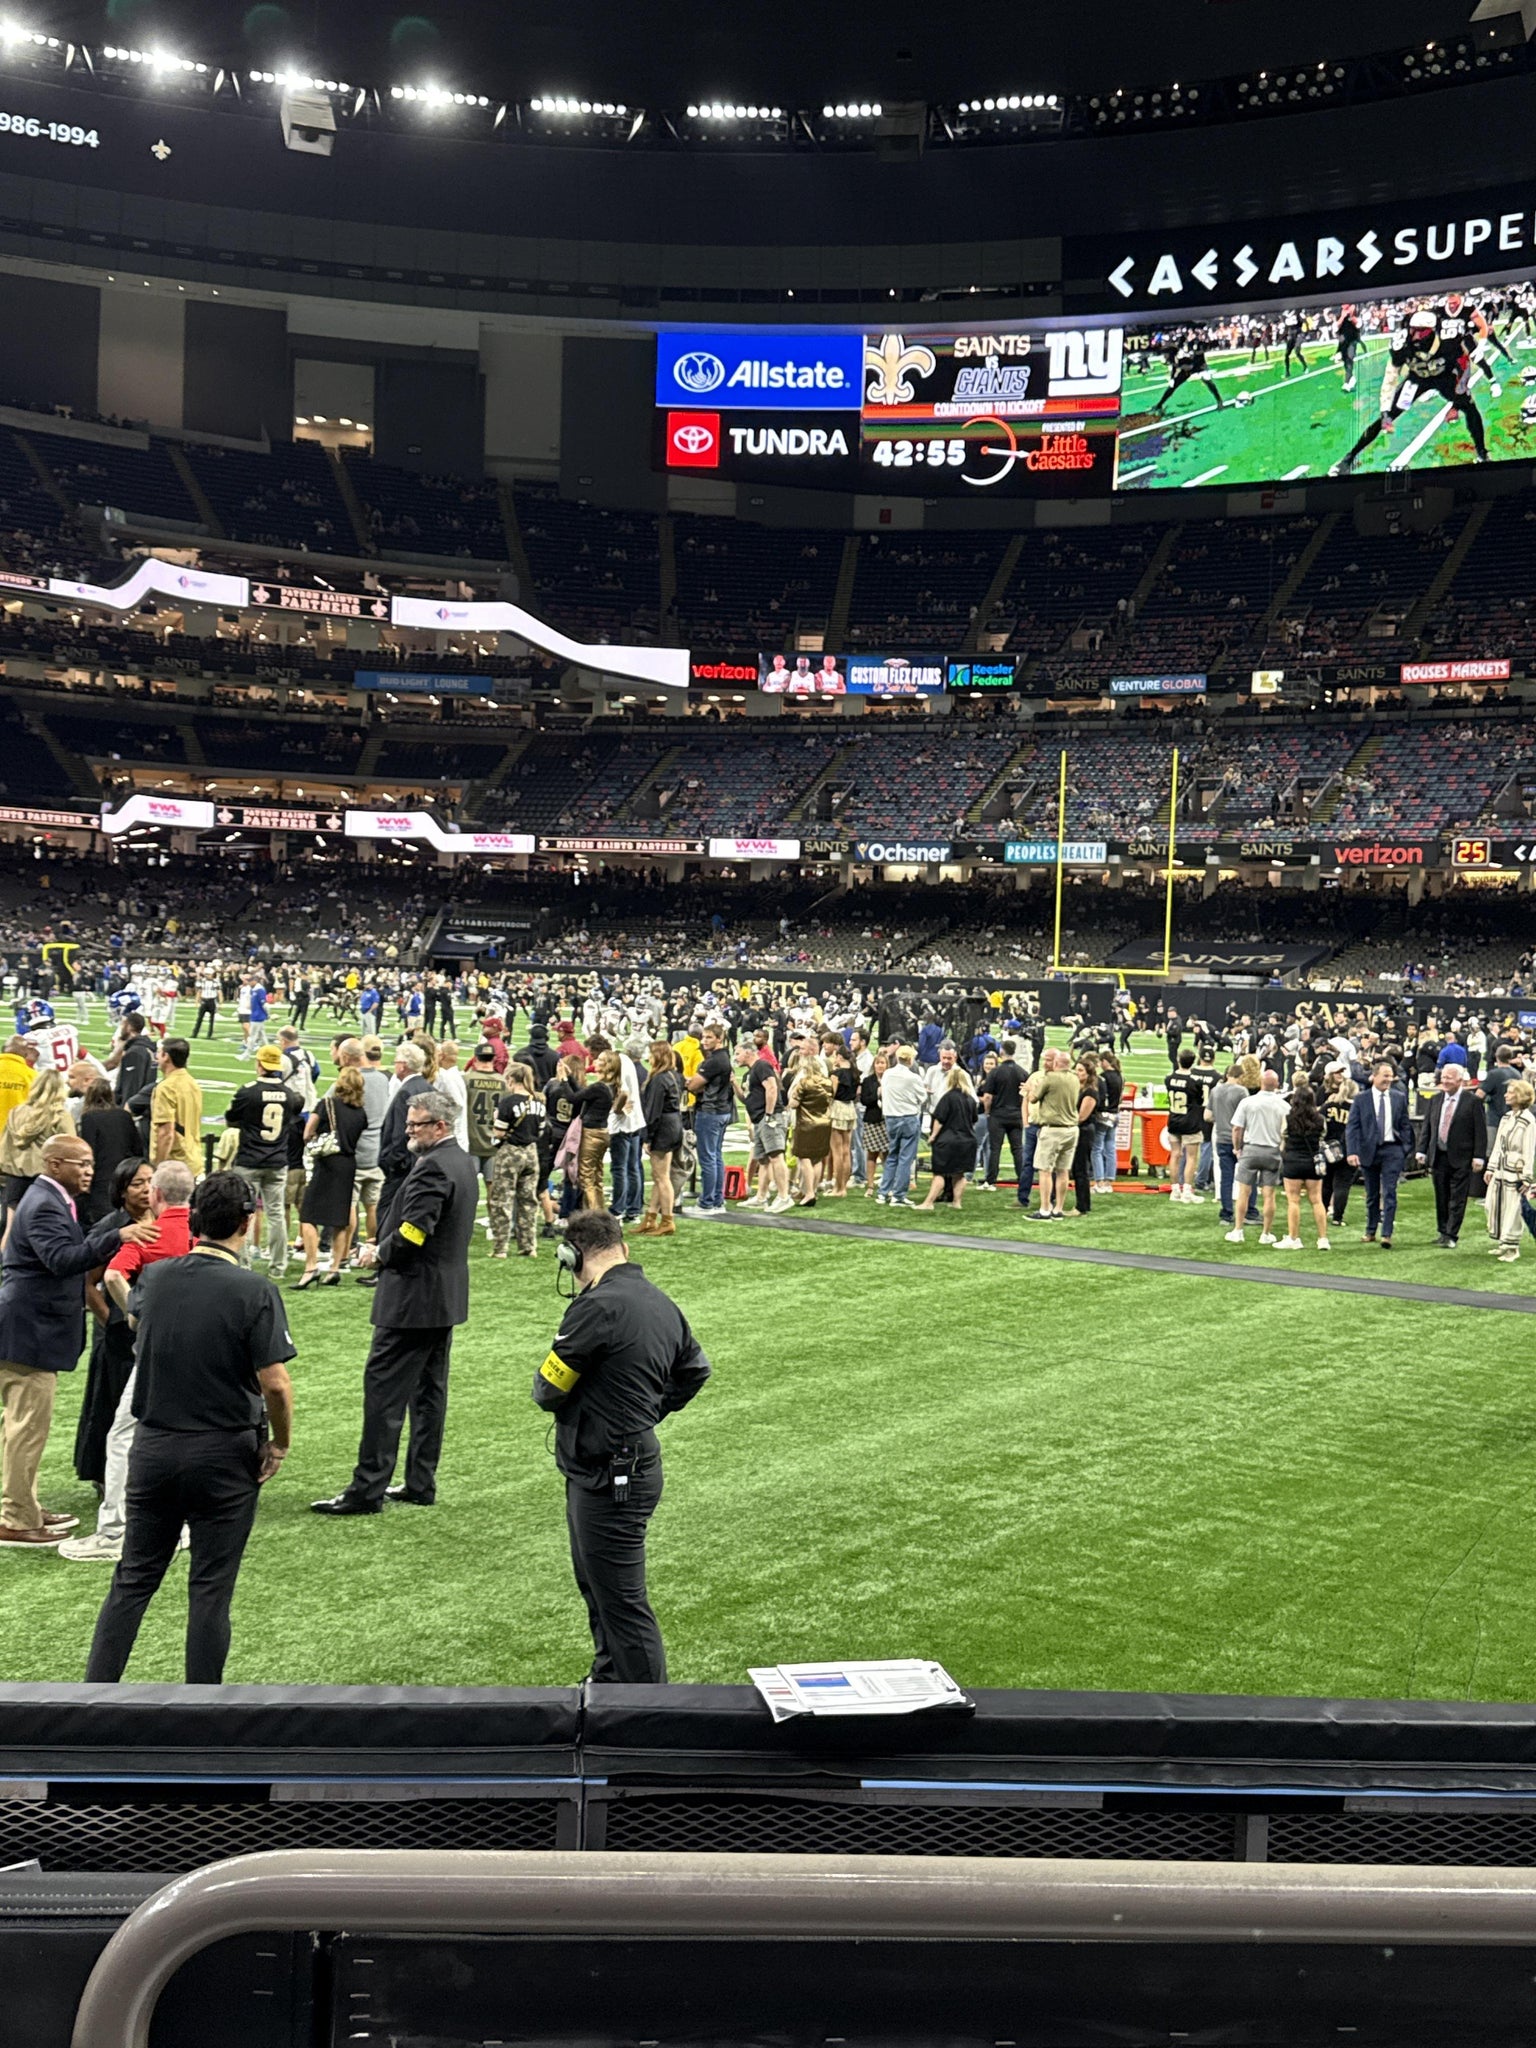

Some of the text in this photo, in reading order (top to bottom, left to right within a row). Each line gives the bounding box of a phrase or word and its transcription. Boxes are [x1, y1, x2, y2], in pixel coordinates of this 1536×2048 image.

[0, 112, 100, 148] 986-1994
[1394, 212, 1536, 267] SUPE
[954, 335, 1031, 358] SAINTS
[727, 361, 845, 389] Allstate
[952, 366, 1031, 394] GIANTS
[933, 399, 1047, 417] COUNTDOWN TO KICKOFF
[729, 428, 849, 456] TUNDRA
[1040, 434, 1088, 455] Little
[873, 440, 966, 467] 42:55
[1026, 450, 1094, 471] Caesars
[281, 596, 361, 615] PARTNERS
[53, 644, 100, 659] SAINTS
[154, 656, 201, 670] SAINTS
[255, 664, 301, 679] SAINTS
[691, 661, 757, 681] verizon
[972, 663, 1015, 676] Keesler
[1402, 660, 1509, 680] ROUSES MARKETS
[850, 666, 942, 686] CUSTOM FLEX PLANS
[972, 675, 1014, 687] Federal
[1336, 666, 1386, 681] SAINTS
[434, 678, 469, 689] LOUNGE
[1055, 679, 1100, 691] SAINTS
[1111, 678, 1205, 692] VENTURE GLOBAL
[27, 812, 83, 825] PARTNERS
[243, 816, 318, 829] PARTNERS
[473, 834, 514, 844] WWL
[556, 840, 687, 851] PATRON SAINTS PARTNERS
[735, 838, 778, 849] WWL
[804, 840, 849, 853] SAINTS
[868, 843, 950, 862] Ochsner
[1007, 845, 1103, 860] PEOPLES HEALTH
[1240, 842, 1293, 856] SAINTS
[1334, 842, 1423, 864] verizon
[1457, 842, 1486, 864] 25
[1146, 951, 1286, 965] SAINTS
[51, 1038, 74, 1072] 51
[1168, 1091, 1188, 1115] 12
[260, 1103, 284, 1142] 9
